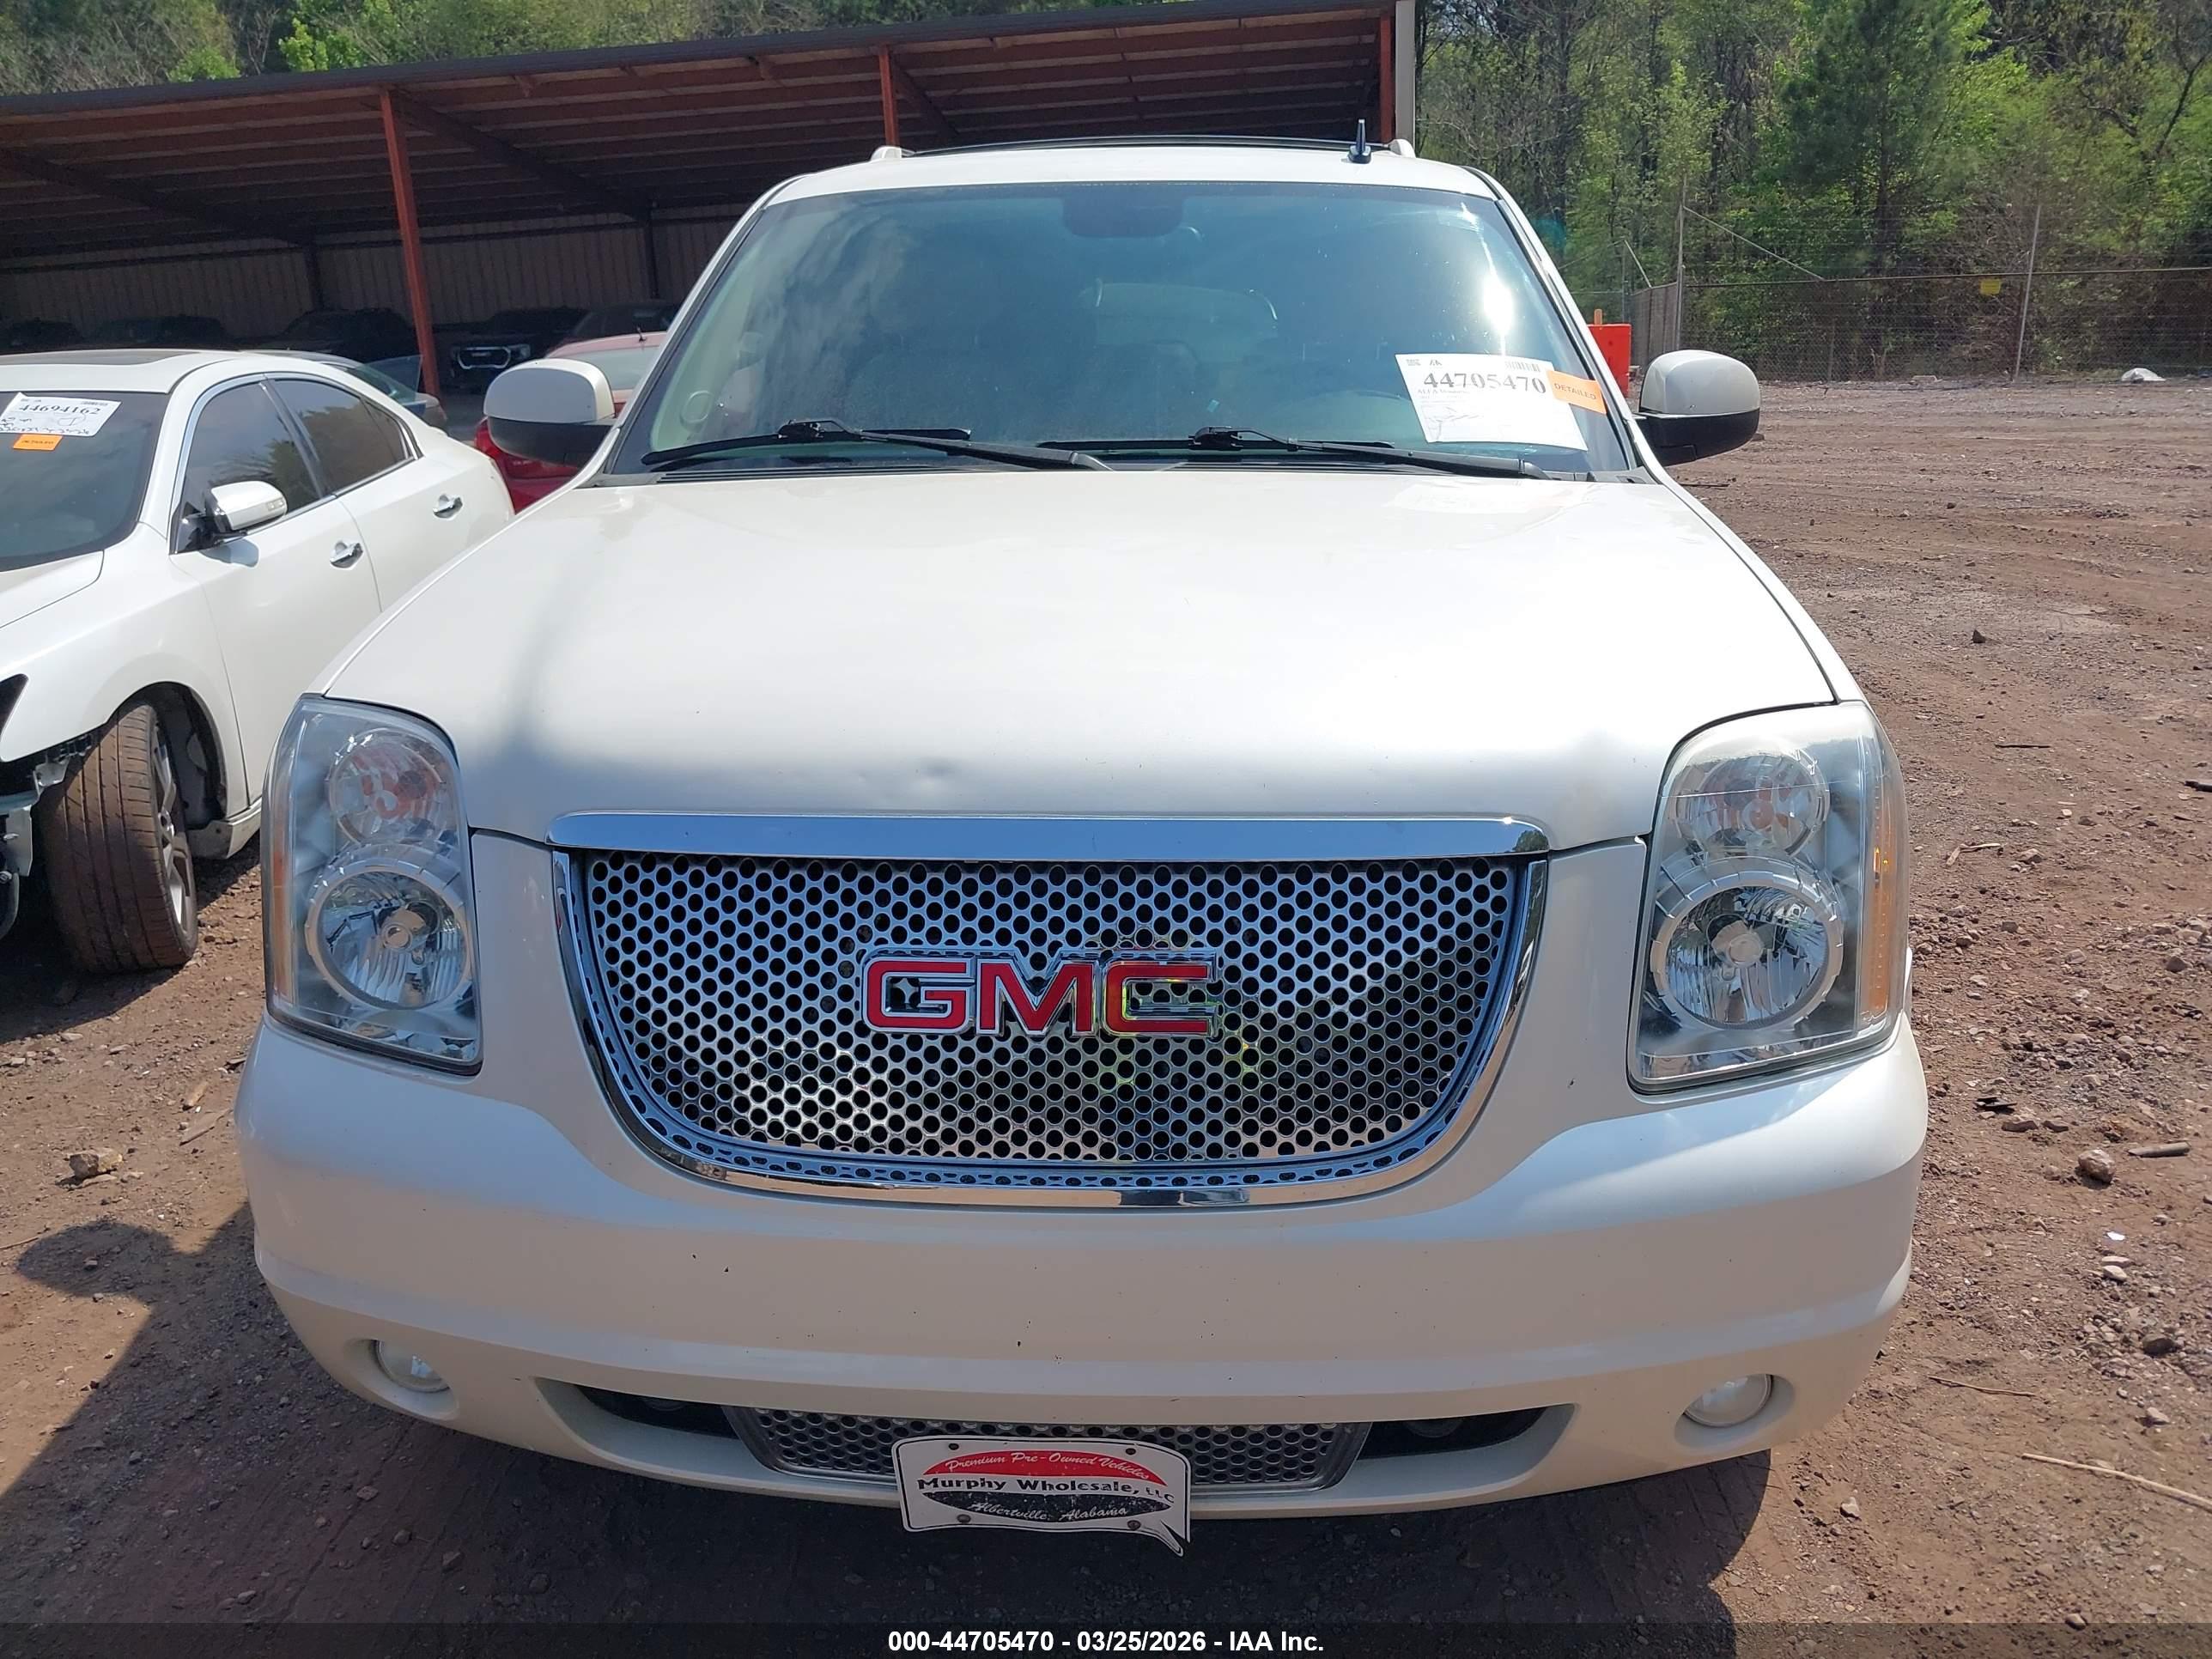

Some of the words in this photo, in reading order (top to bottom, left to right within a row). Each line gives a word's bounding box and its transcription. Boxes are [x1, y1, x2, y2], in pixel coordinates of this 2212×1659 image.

[1423, 372, 1546, 393] 44705470
[1553, 383, 1596, 399] DETAILED
[19, 404, 100, 415] 44694162
[862, 949, 1218, 1036] GMC
[945, 1456, 1006, 1472] Premium
[1098, 1457, 1150, 1480] Vehicles
[917, 1477, 1006, 1491] Murphy
[1017, 1479, 1139, 1495] Wholesale,
[1146, 1486, 1175, 1504] LLC
[1058, 1506, 1128, 1521] Alabama
